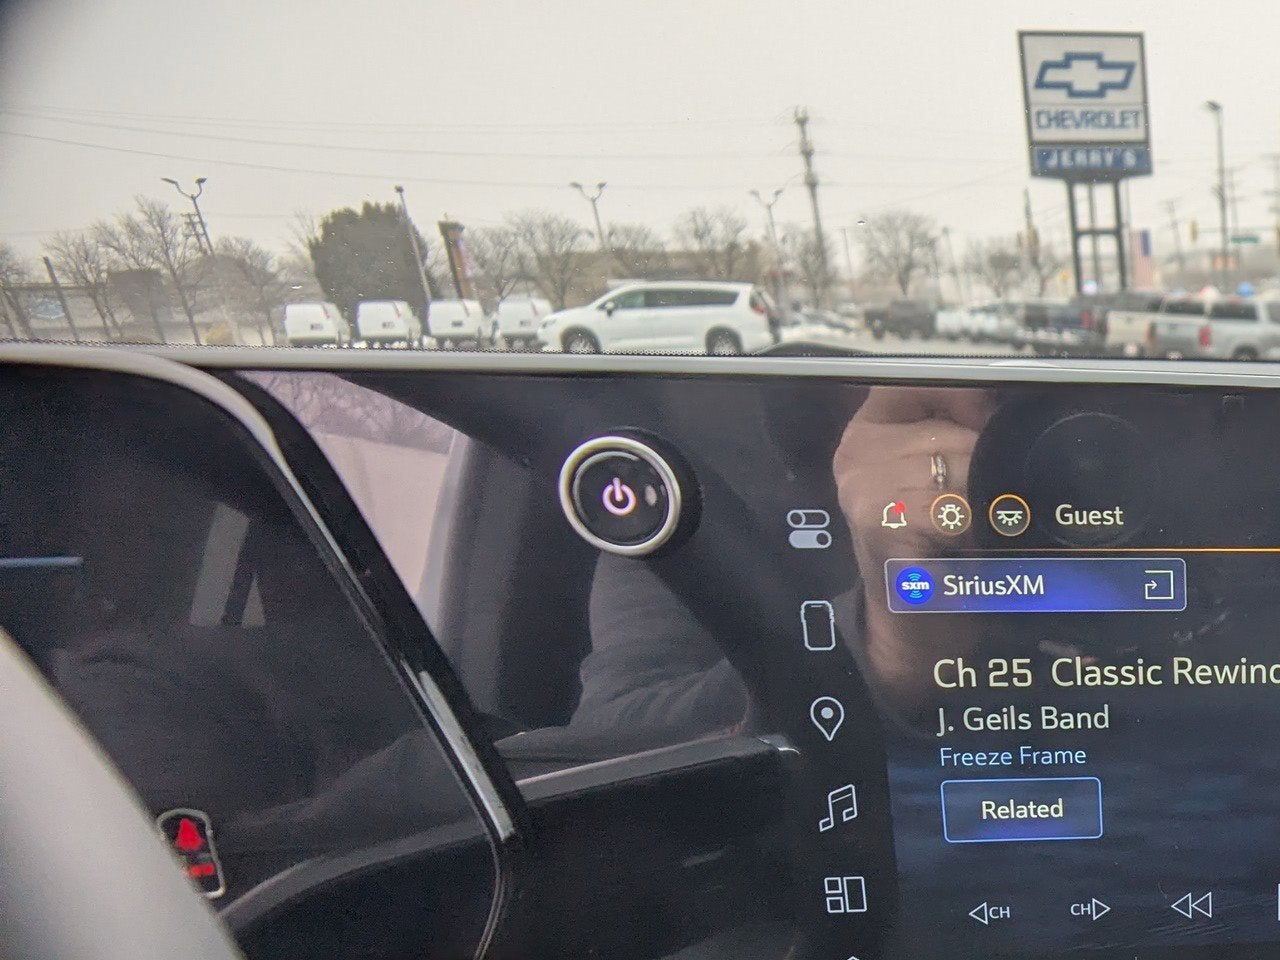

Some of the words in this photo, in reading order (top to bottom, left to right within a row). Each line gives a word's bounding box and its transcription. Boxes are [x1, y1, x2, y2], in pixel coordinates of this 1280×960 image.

[1036, 110, 1141, 129] CHEVROLET
[1055, 505, 1124, 527] Guest
[901, 579, 930, 591] sxm
[943, 574, 1045, 596] SiriusXM
[933, 658, 977, 689] Ch
[987, 658, 1033, 688] 25
[1051, 657, 1163, 687] Classic
[936, 707, 955, 737] J.
[963, 706, 1032, 732] Geils
[1041, 704, 1110, 730] Band
[940, 747, 1013, 767] Freeze
[1019, 746, 1087, 765] Frame
[981, 798, 1064, 820] Related
[989, 906, 1011, 920] CH
[1070, 902, 1092, 917] CH
